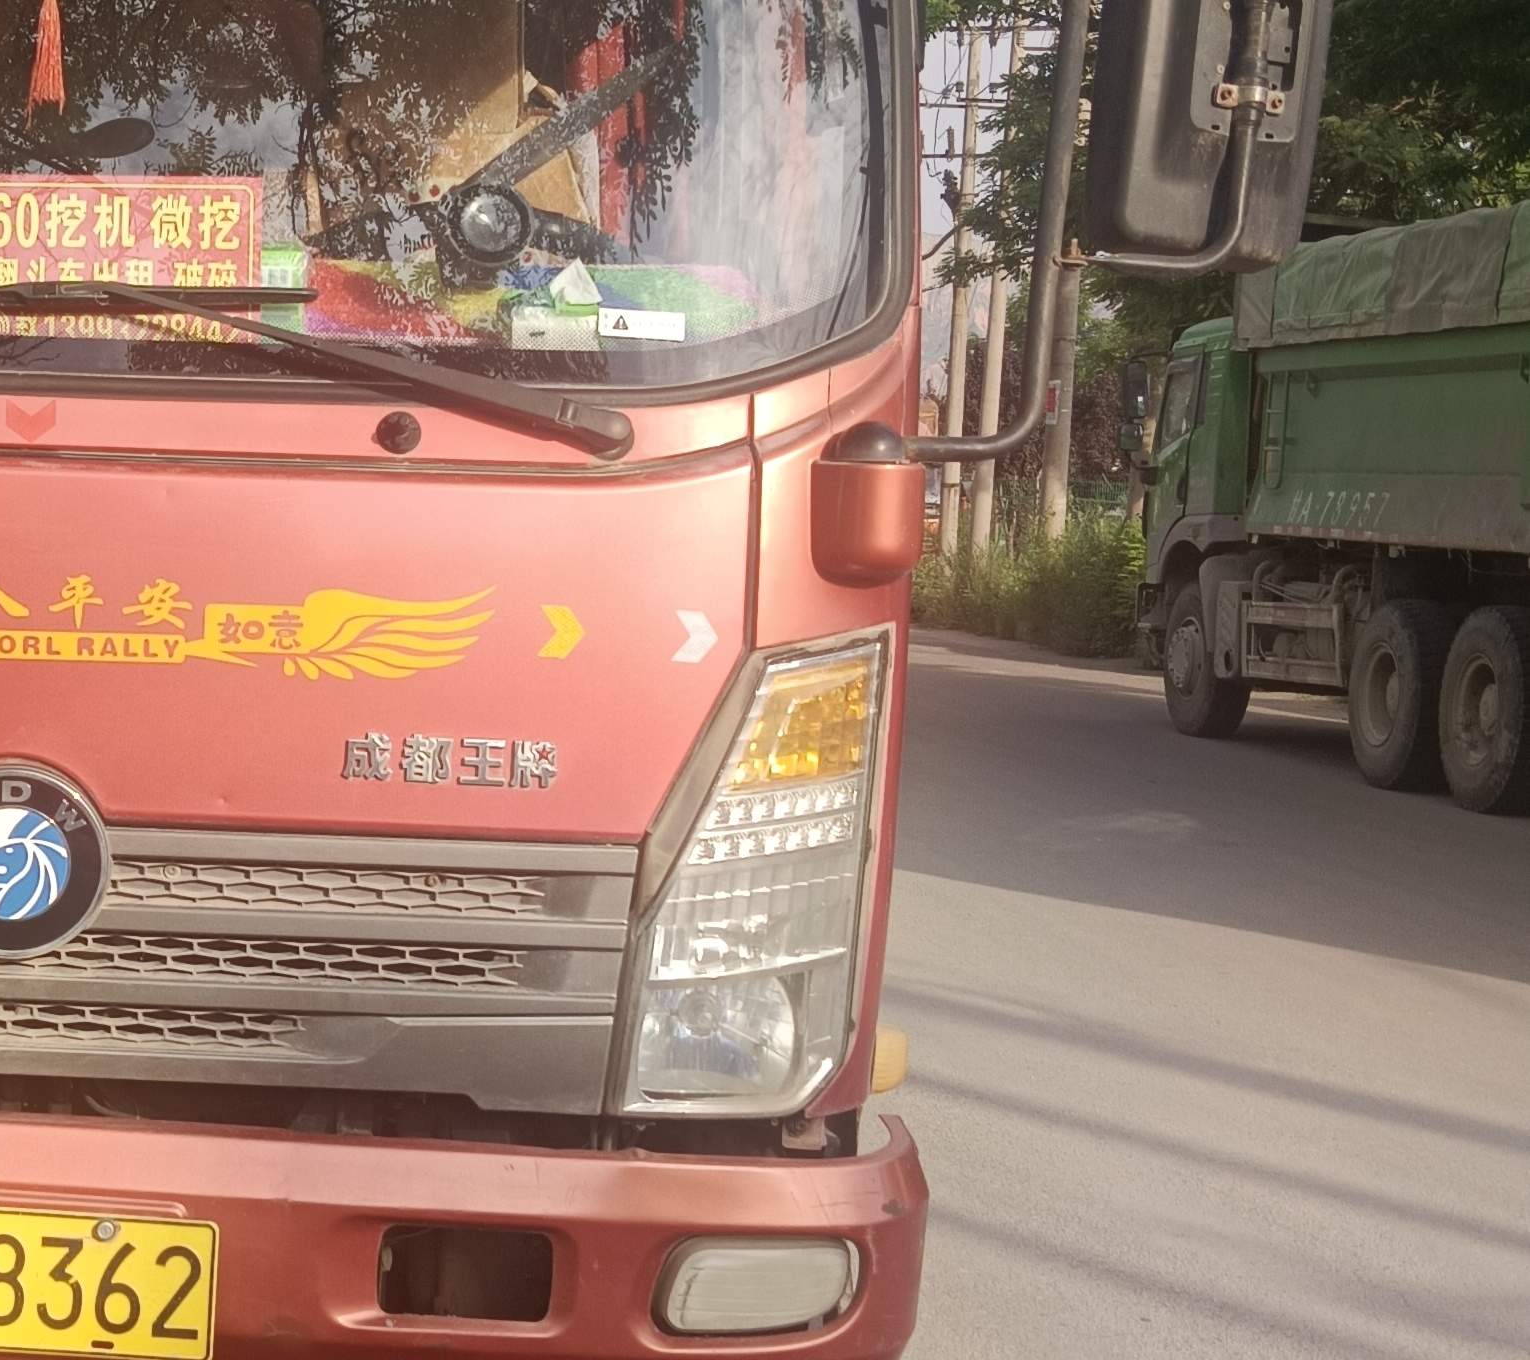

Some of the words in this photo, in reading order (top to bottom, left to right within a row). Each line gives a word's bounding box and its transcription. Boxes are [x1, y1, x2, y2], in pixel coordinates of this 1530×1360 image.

[150, 193, 241, 251] 微挖
[77, 636, 179, 658] RALLY
[217, 610, 304, 650] 如意
[341, 732, 557, 788] 成都王牌
